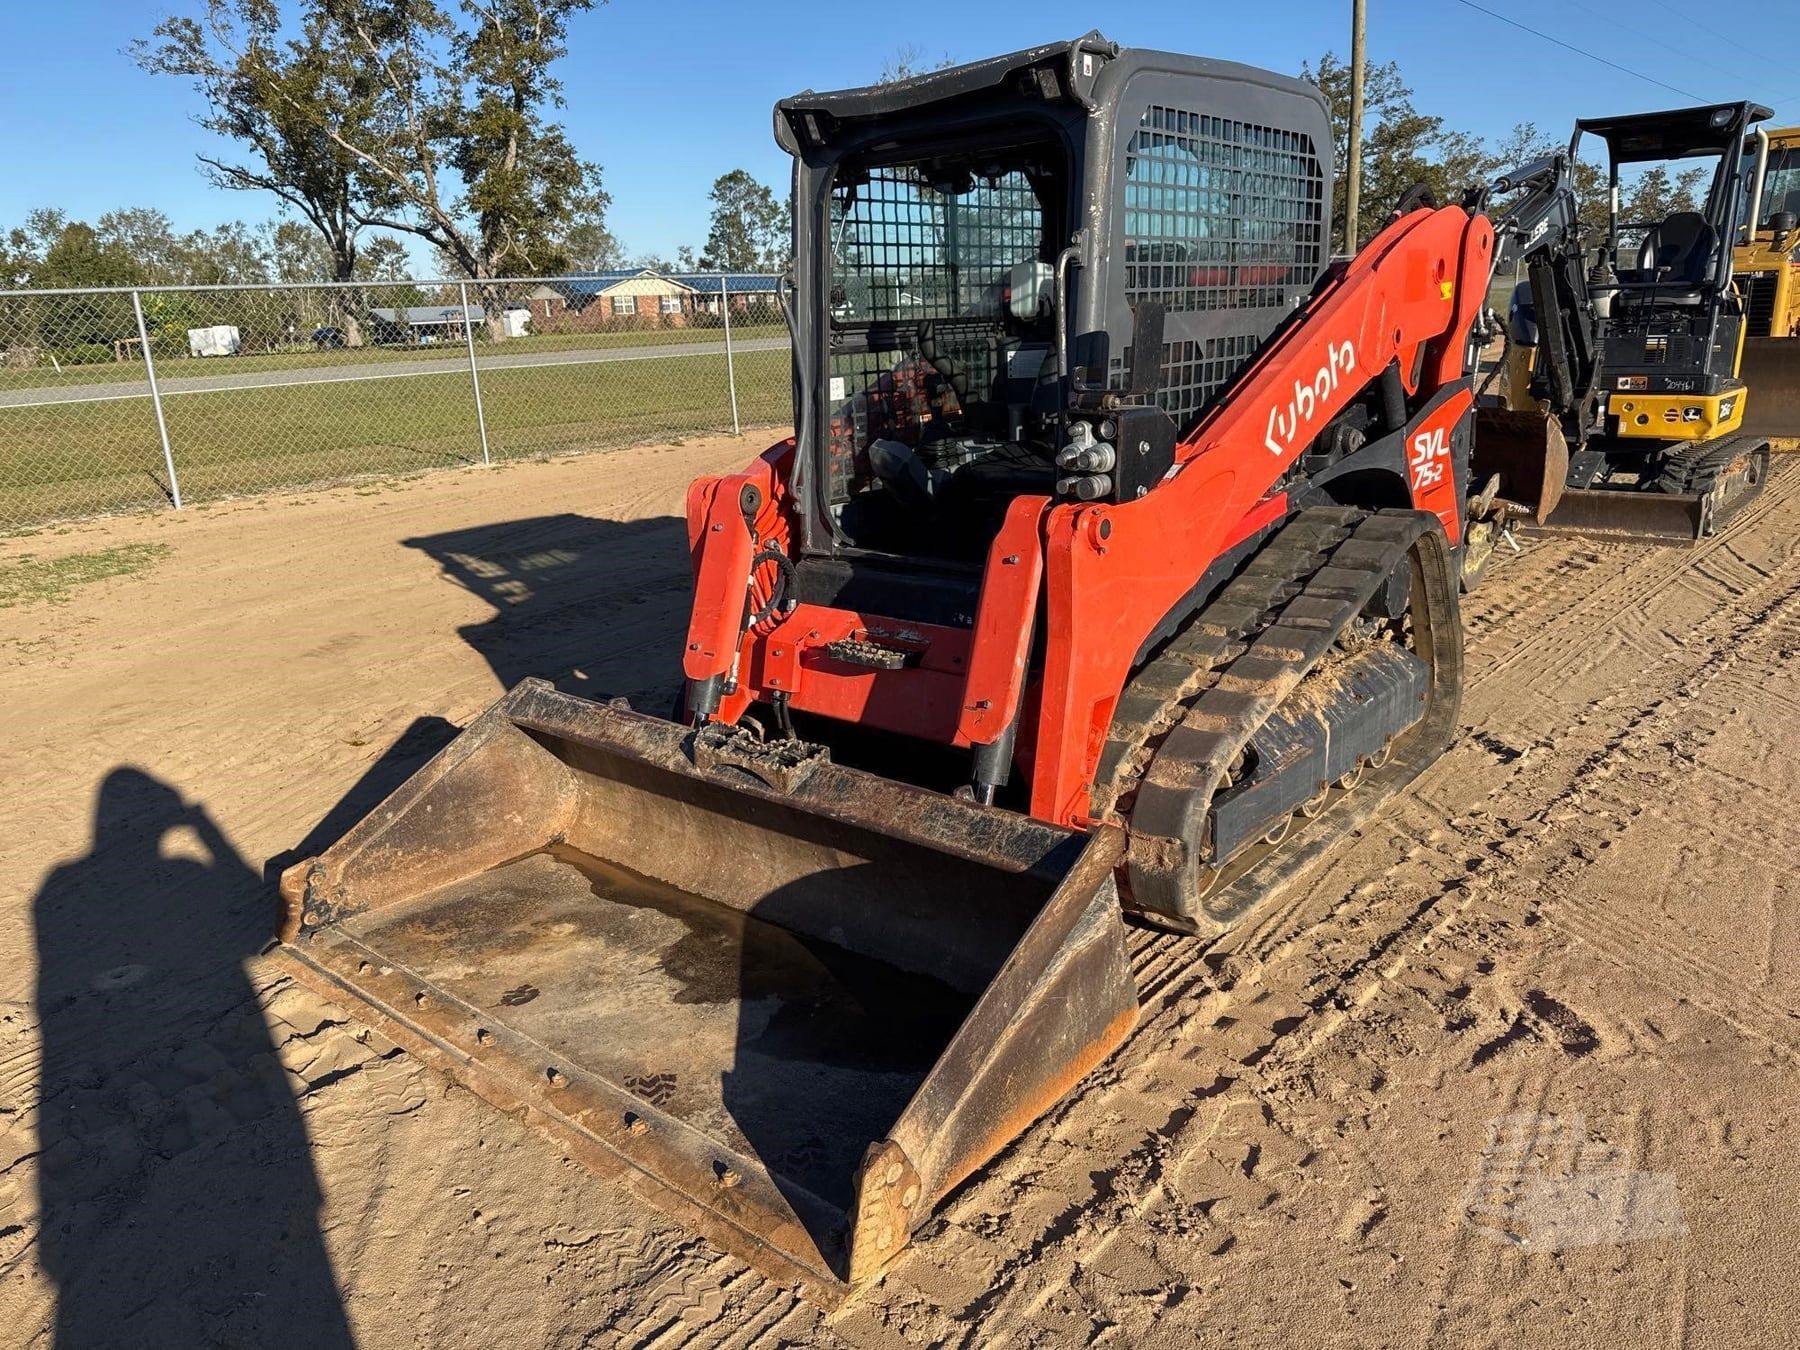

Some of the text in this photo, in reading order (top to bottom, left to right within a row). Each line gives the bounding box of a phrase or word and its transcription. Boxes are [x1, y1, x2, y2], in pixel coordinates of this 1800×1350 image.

[1264, 340, 1355, 456] Kubota
[1411, 427, 1450, 466] SVL
[1413, 461, 1443, 491] 75-2
